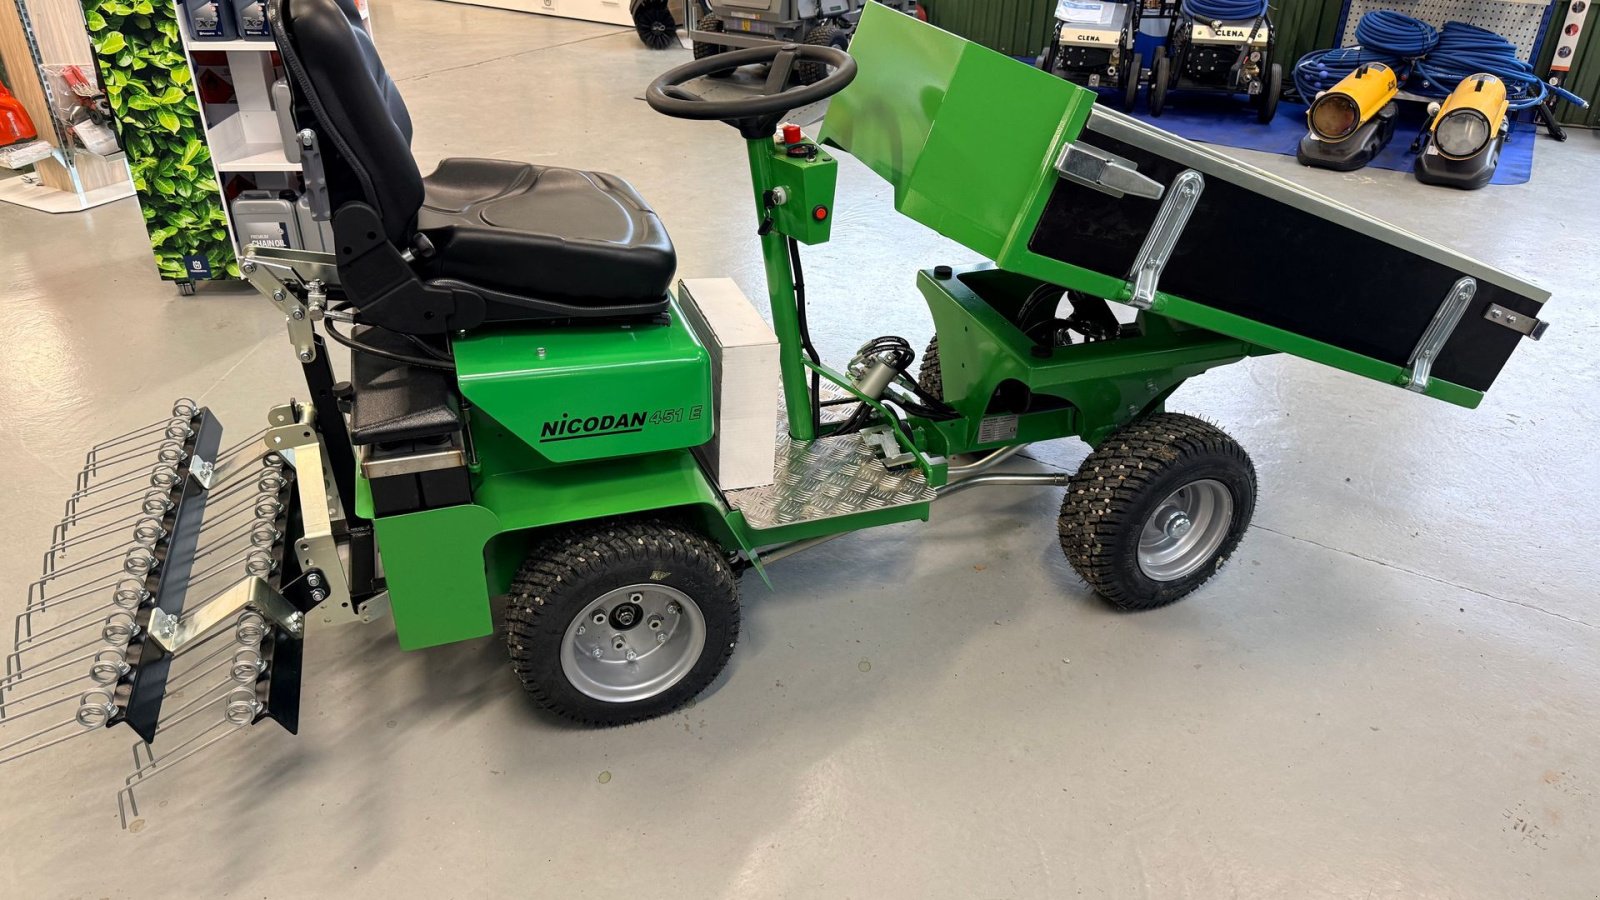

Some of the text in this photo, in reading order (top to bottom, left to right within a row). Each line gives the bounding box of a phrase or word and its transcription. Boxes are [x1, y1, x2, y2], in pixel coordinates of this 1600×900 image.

[1215, 29, 1244, 37] CLENA
[1077, 34, 1101, 42] CLENA
[649, 407, 684, 425] 451
[689, 405, 703, 421] E
